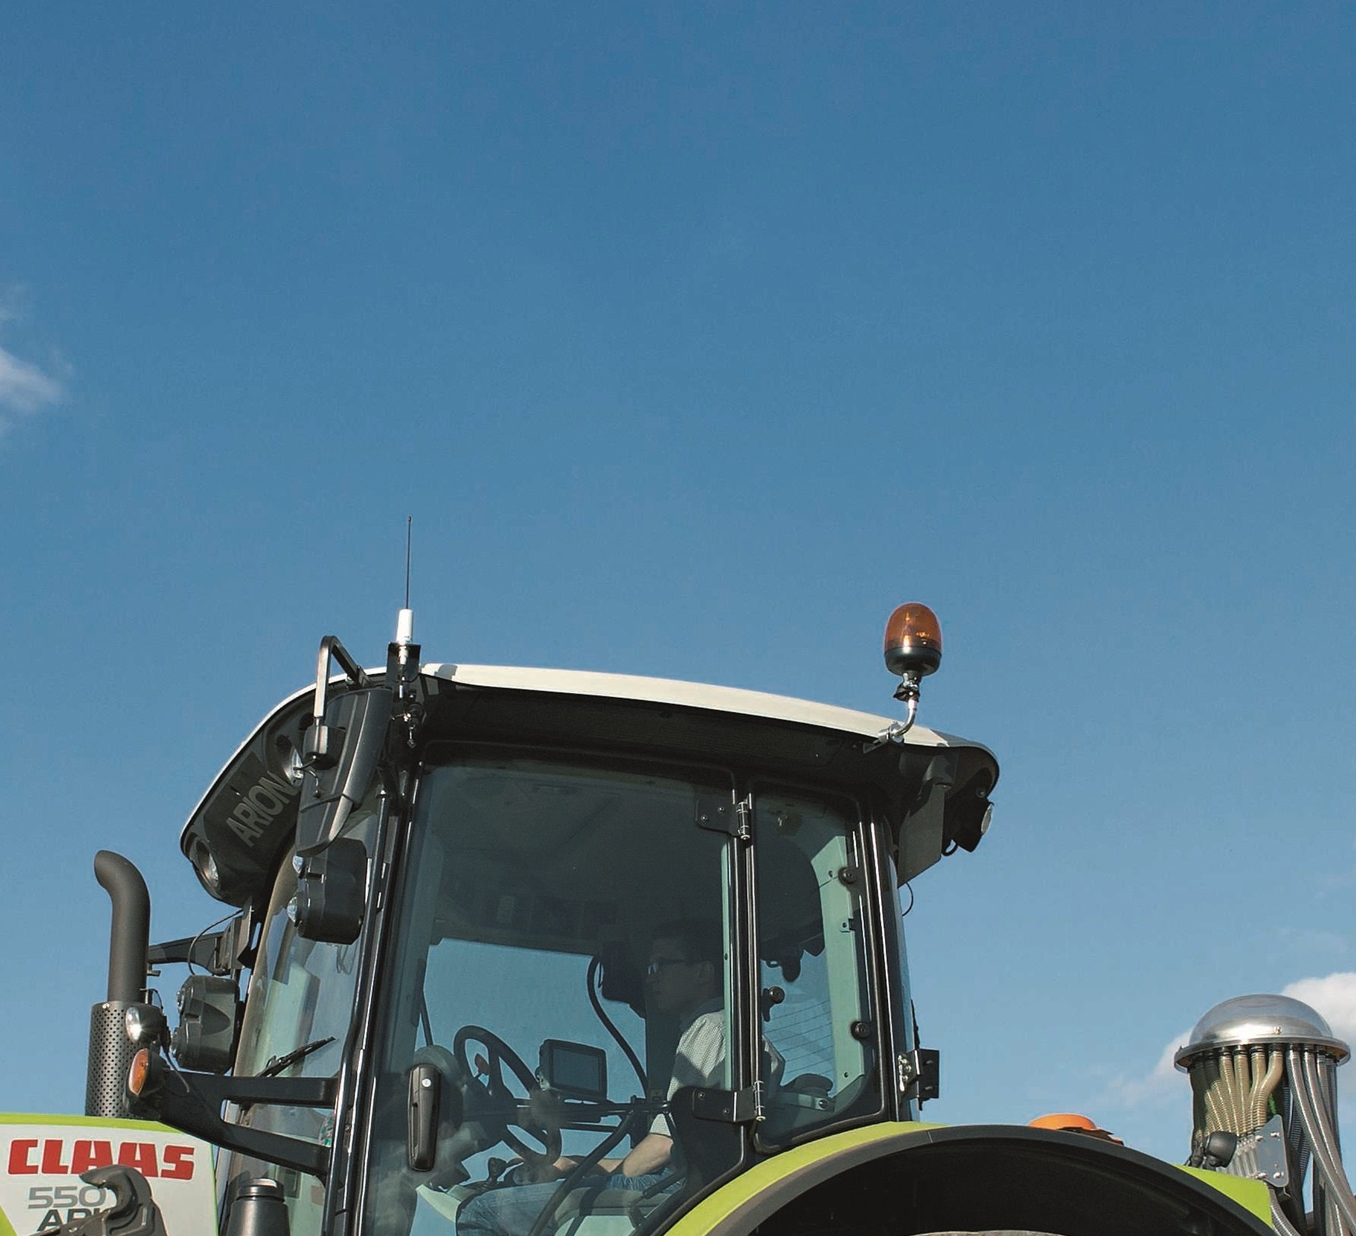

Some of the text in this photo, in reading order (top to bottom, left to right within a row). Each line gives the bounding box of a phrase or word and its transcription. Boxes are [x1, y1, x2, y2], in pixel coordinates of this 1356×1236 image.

[226, 770, 299, 848] ARION
[8, 1139, 194, 1180] CLAAS
[28, 1186, 106, 1209] 550
